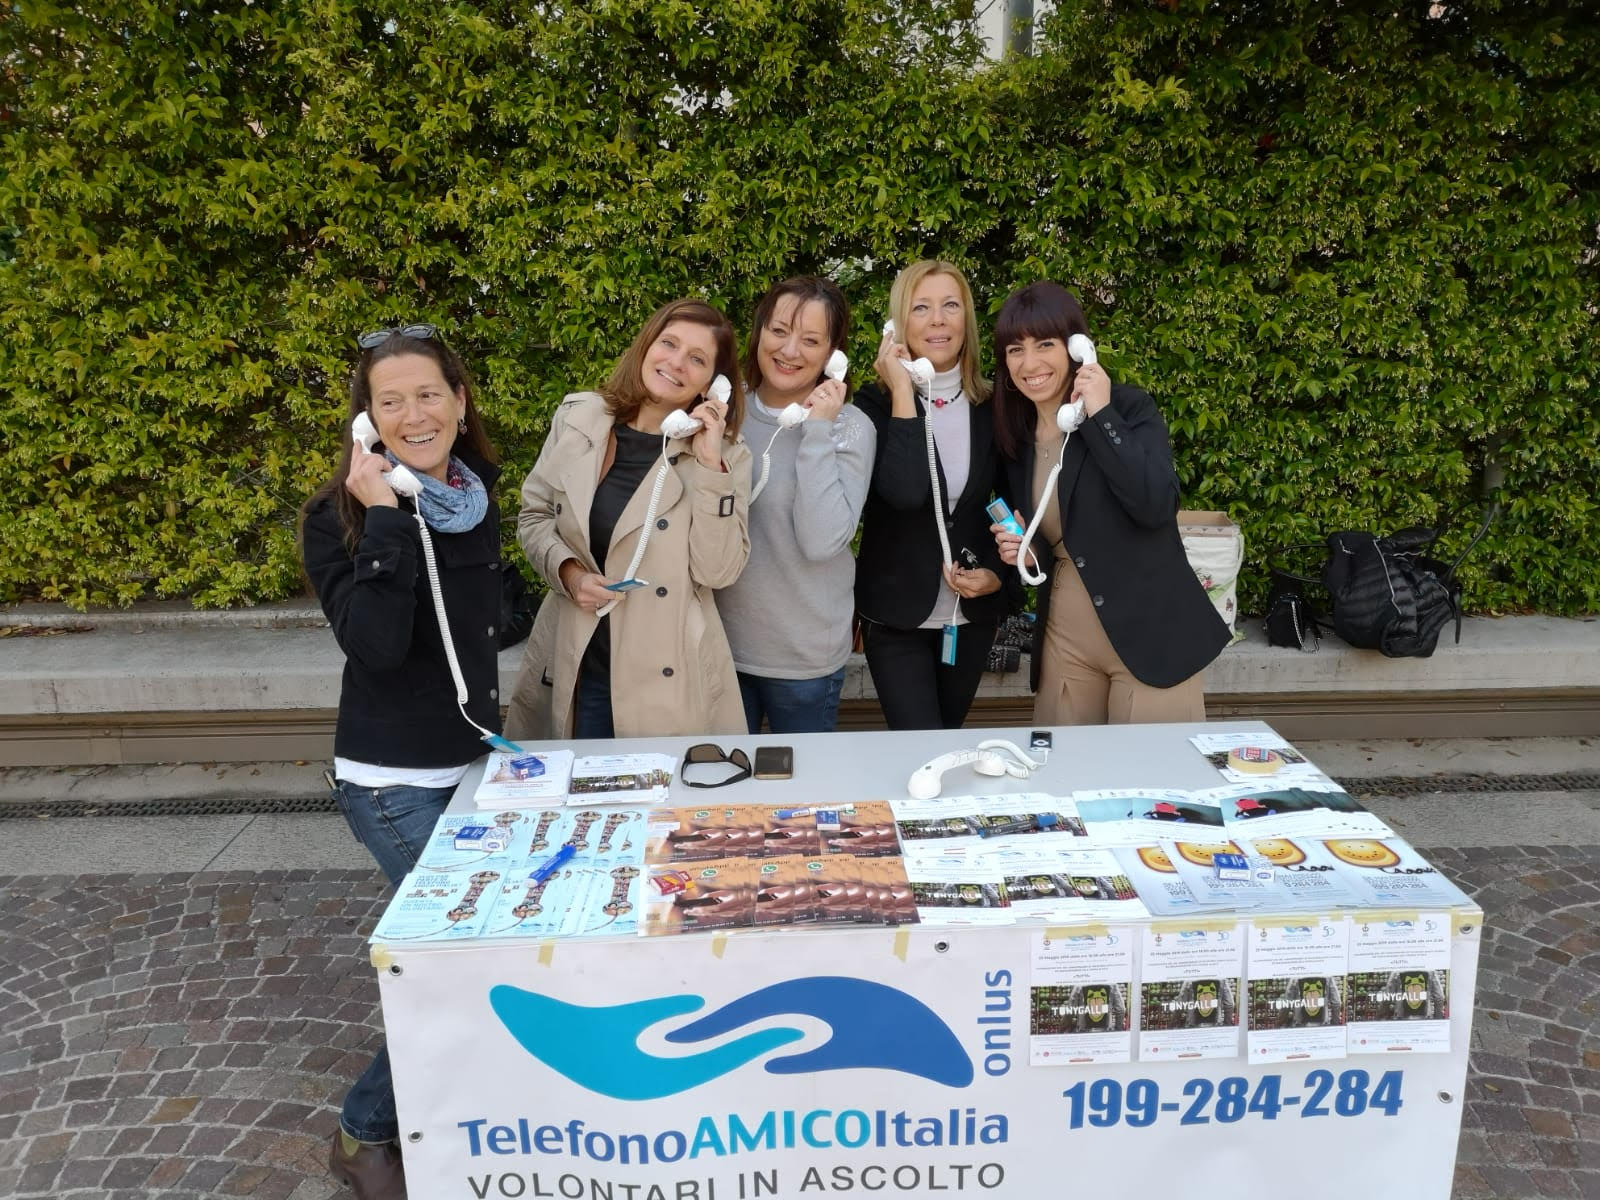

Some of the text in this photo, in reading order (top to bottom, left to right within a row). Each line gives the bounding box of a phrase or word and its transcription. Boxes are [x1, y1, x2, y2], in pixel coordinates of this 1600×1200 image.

[1051, 1003, 1109, 1016] TONYGALLO
[1161, 998, 1218, 1012] TONYGALLO
[1268, 998, 1325, 1010] TONYGALLO
[1368, 991, 1428, 1002] TONYGALLO
[983, 969, 1012, 1077] onlus
[1062, 1068, 1404, 1130] 199-284-284
[457, 1107, 1009, 1165] TelefonoAMICOItalia
[467, 1162, 1005, 1200] VOLONTARI IN ASCOLTO
